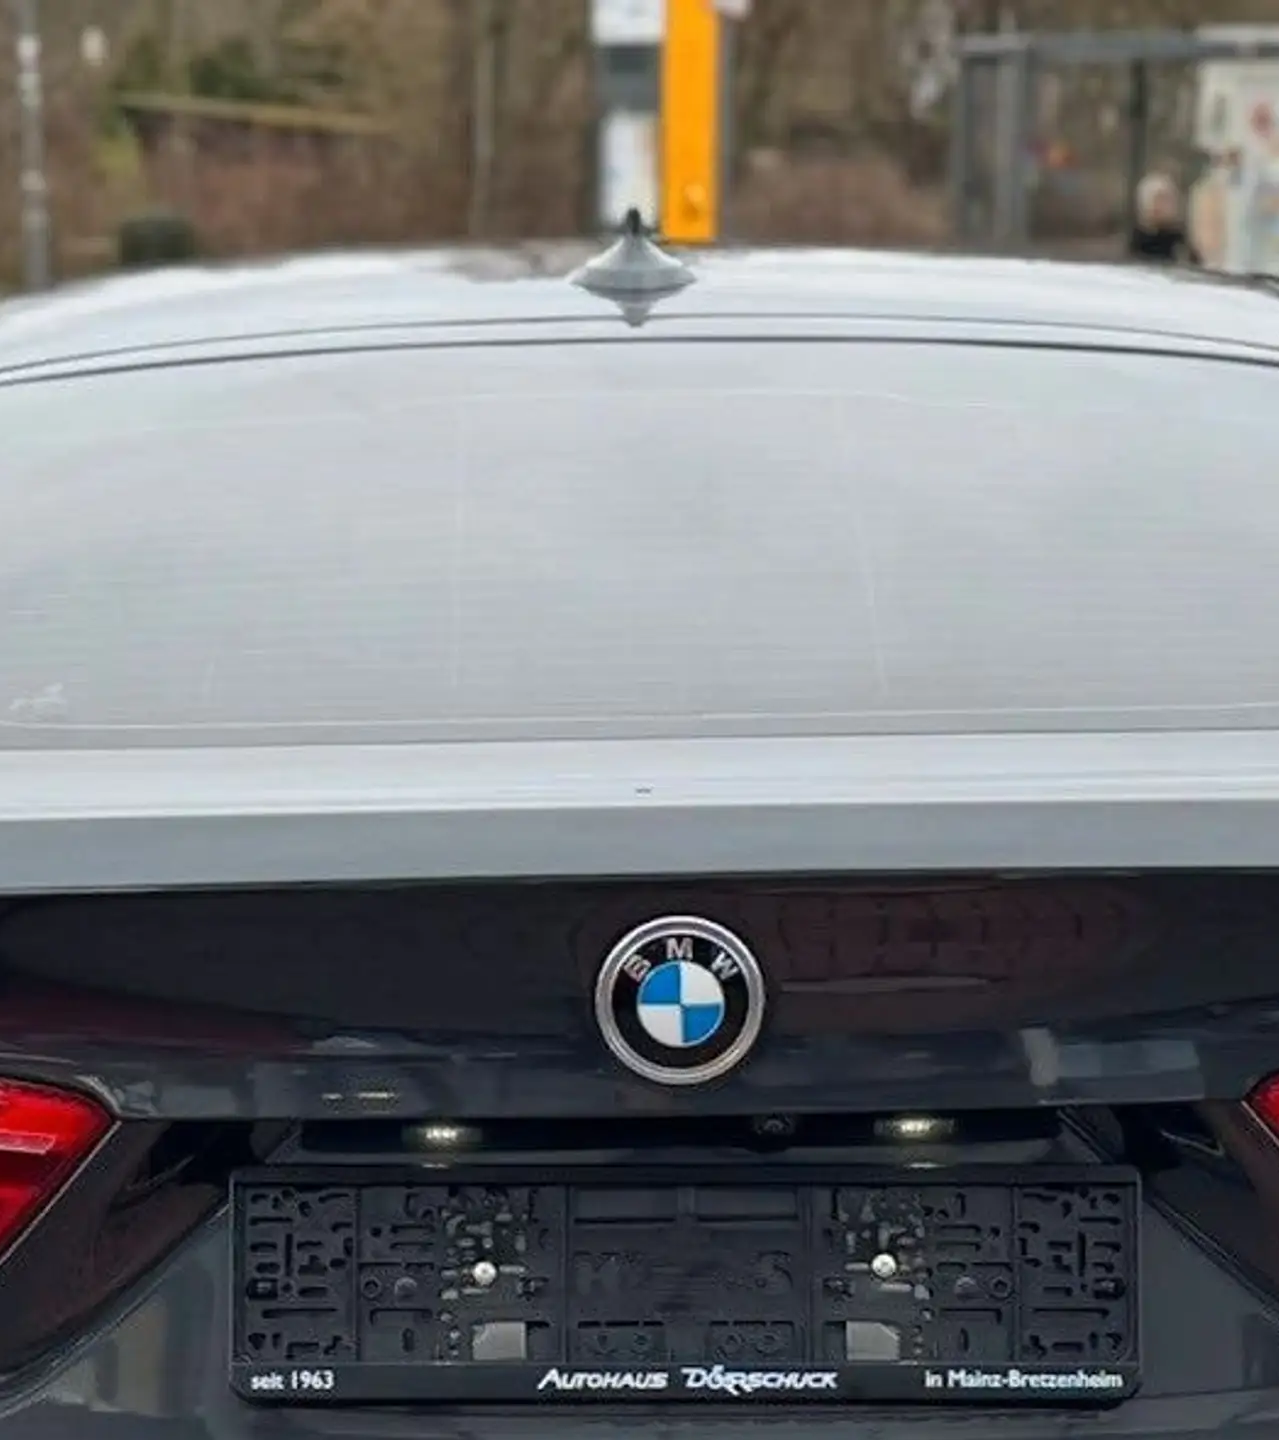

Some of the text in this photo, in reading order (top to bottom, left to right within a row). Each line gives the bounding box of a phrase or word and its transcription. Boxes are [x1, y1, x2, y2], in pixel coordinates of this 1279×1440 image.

[623, 937, 739, 982] BMW
[251, 1370, 335, 1390] seit 1963
[537, 1368, 668, 1390] AUTOHAUS
[925, 1369, 1123, 1389] in Mainz-Bretzenheim
